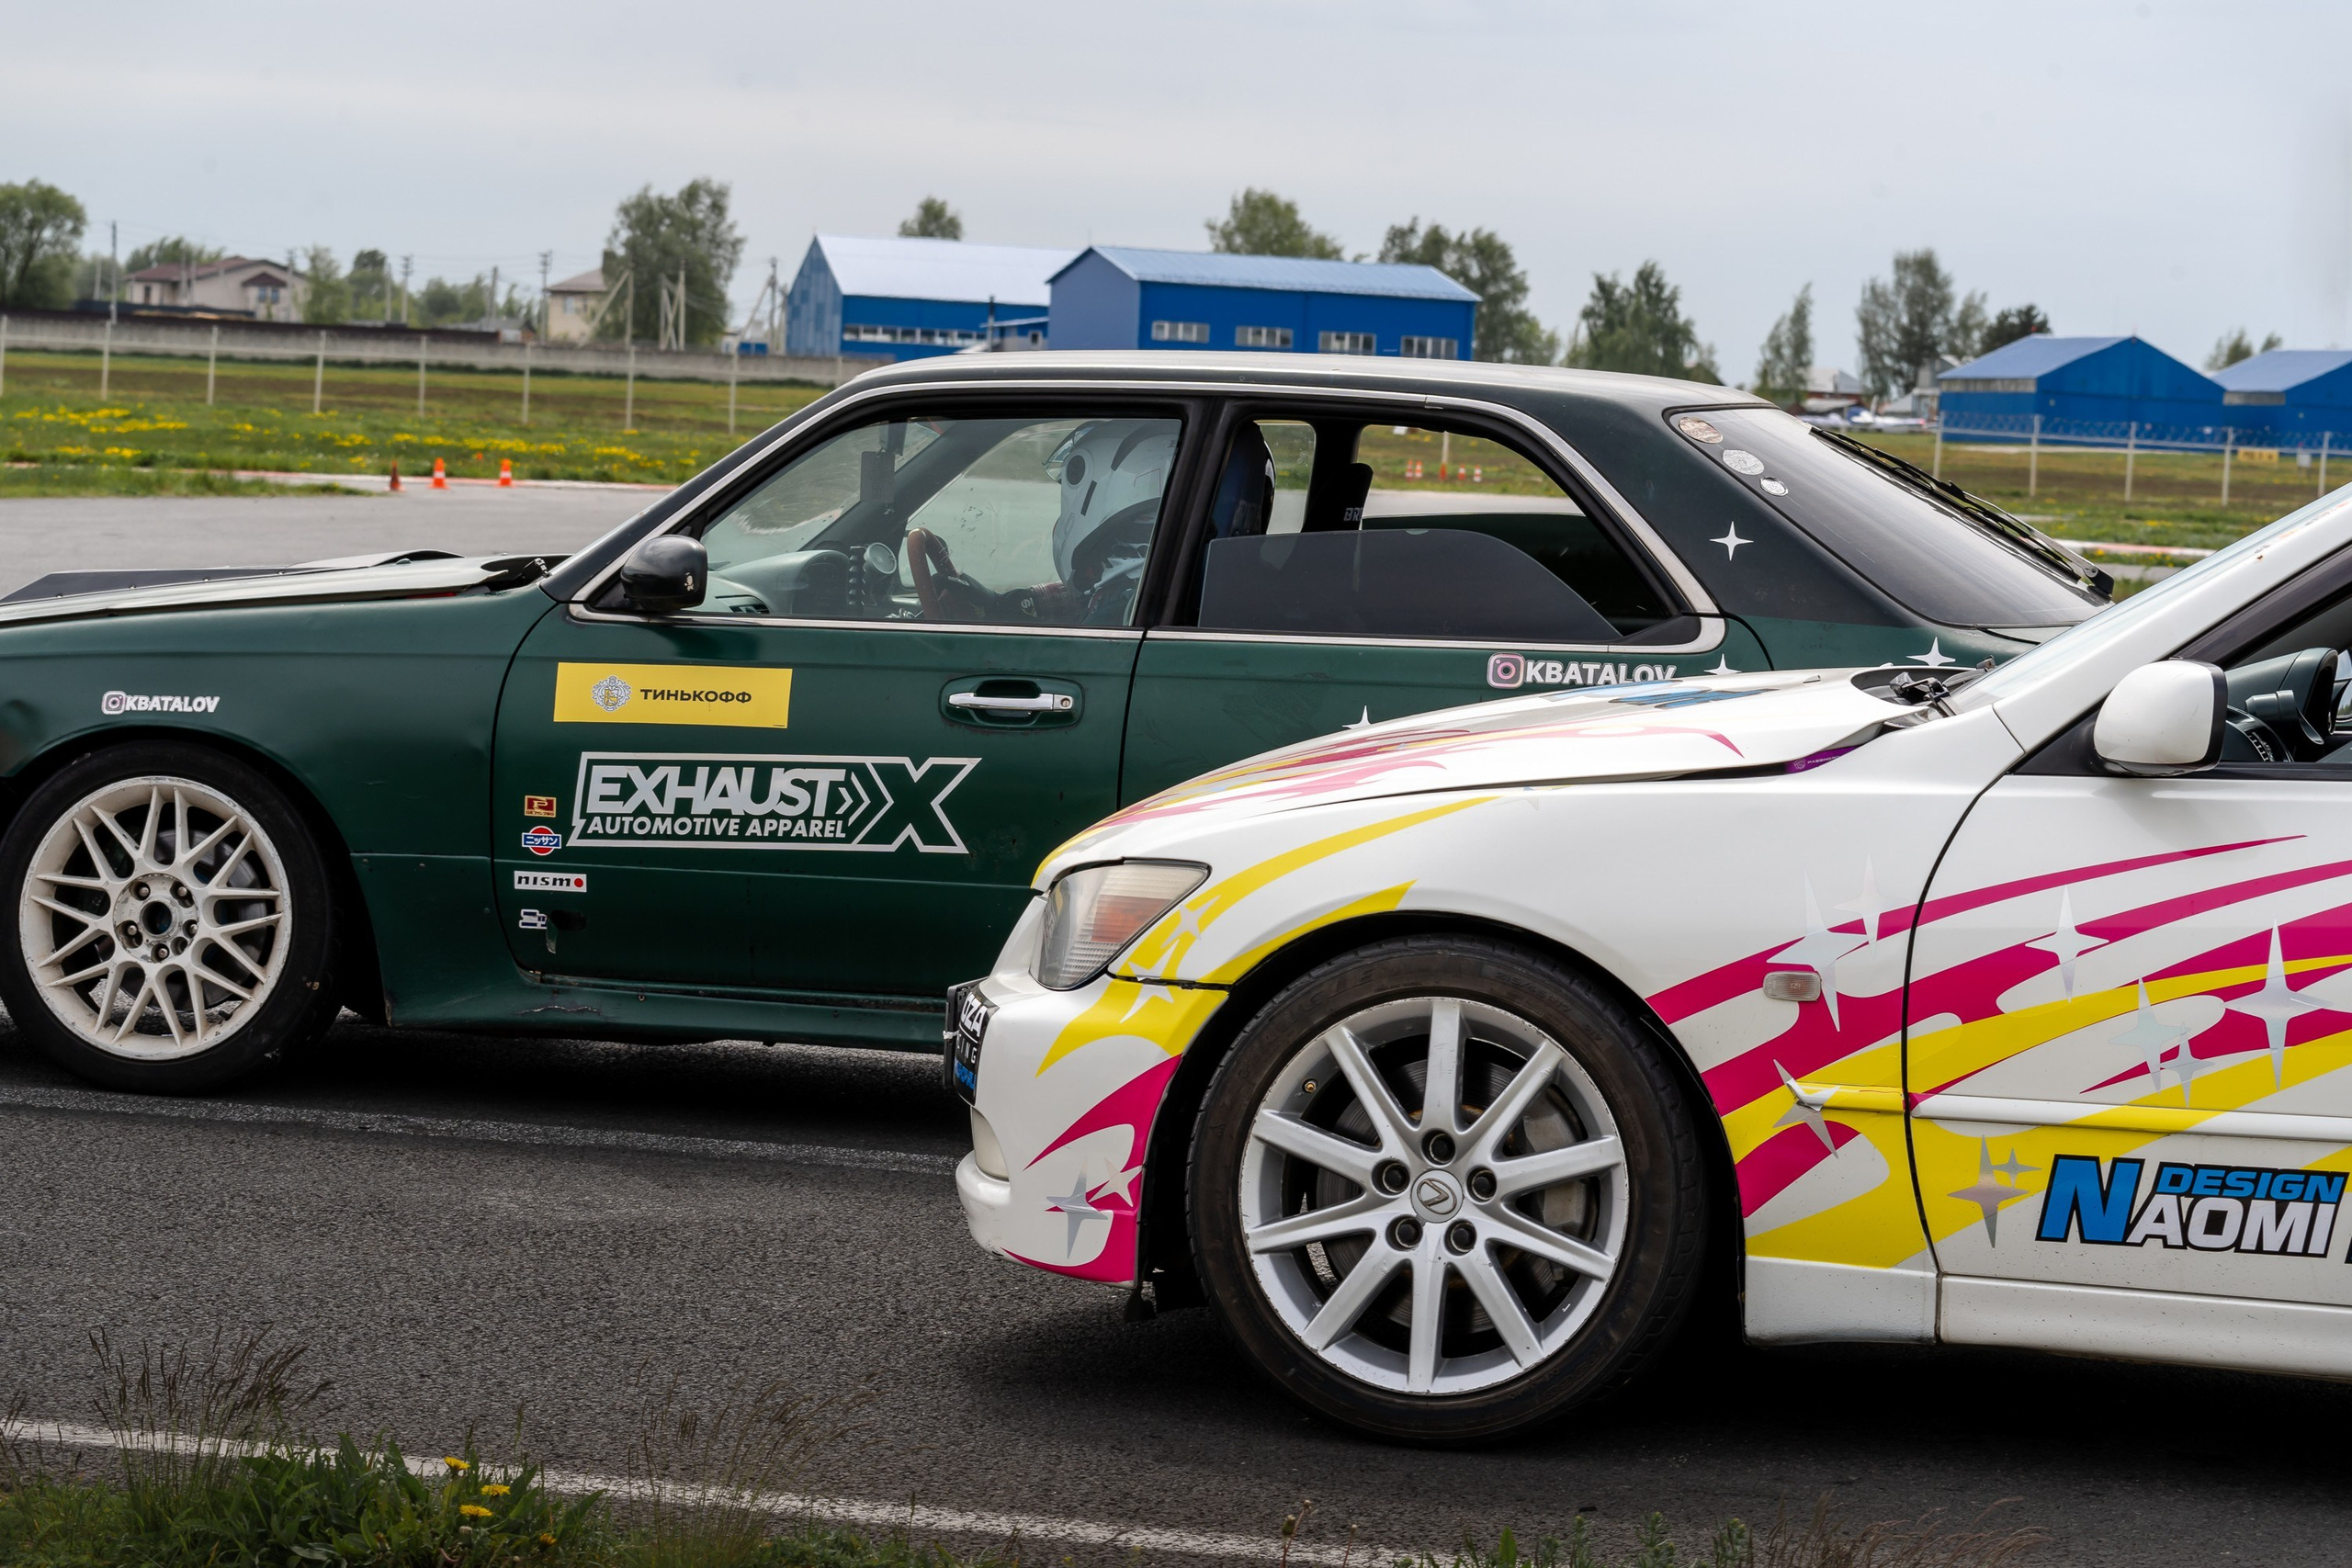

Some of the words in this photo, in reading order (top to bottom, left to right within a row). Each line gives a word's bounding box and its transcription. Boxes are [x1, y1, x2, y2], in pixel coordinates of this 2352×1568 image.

[1526, 661, 1675, 685] KBATALOV
[125, 695, 220, 713] KBATALOV
[640, 689, 752, 704] ТИНЬКОФФ
[586, 765, 846, 817] EXHAUST
[587, 817, 739, 837] AUTOMOTIVE
[745, 819, 846, 839] APPAREL
[526, 836, 558, 846] ニッサン
[2155, 1166, 2346, 1203] DESIGN
